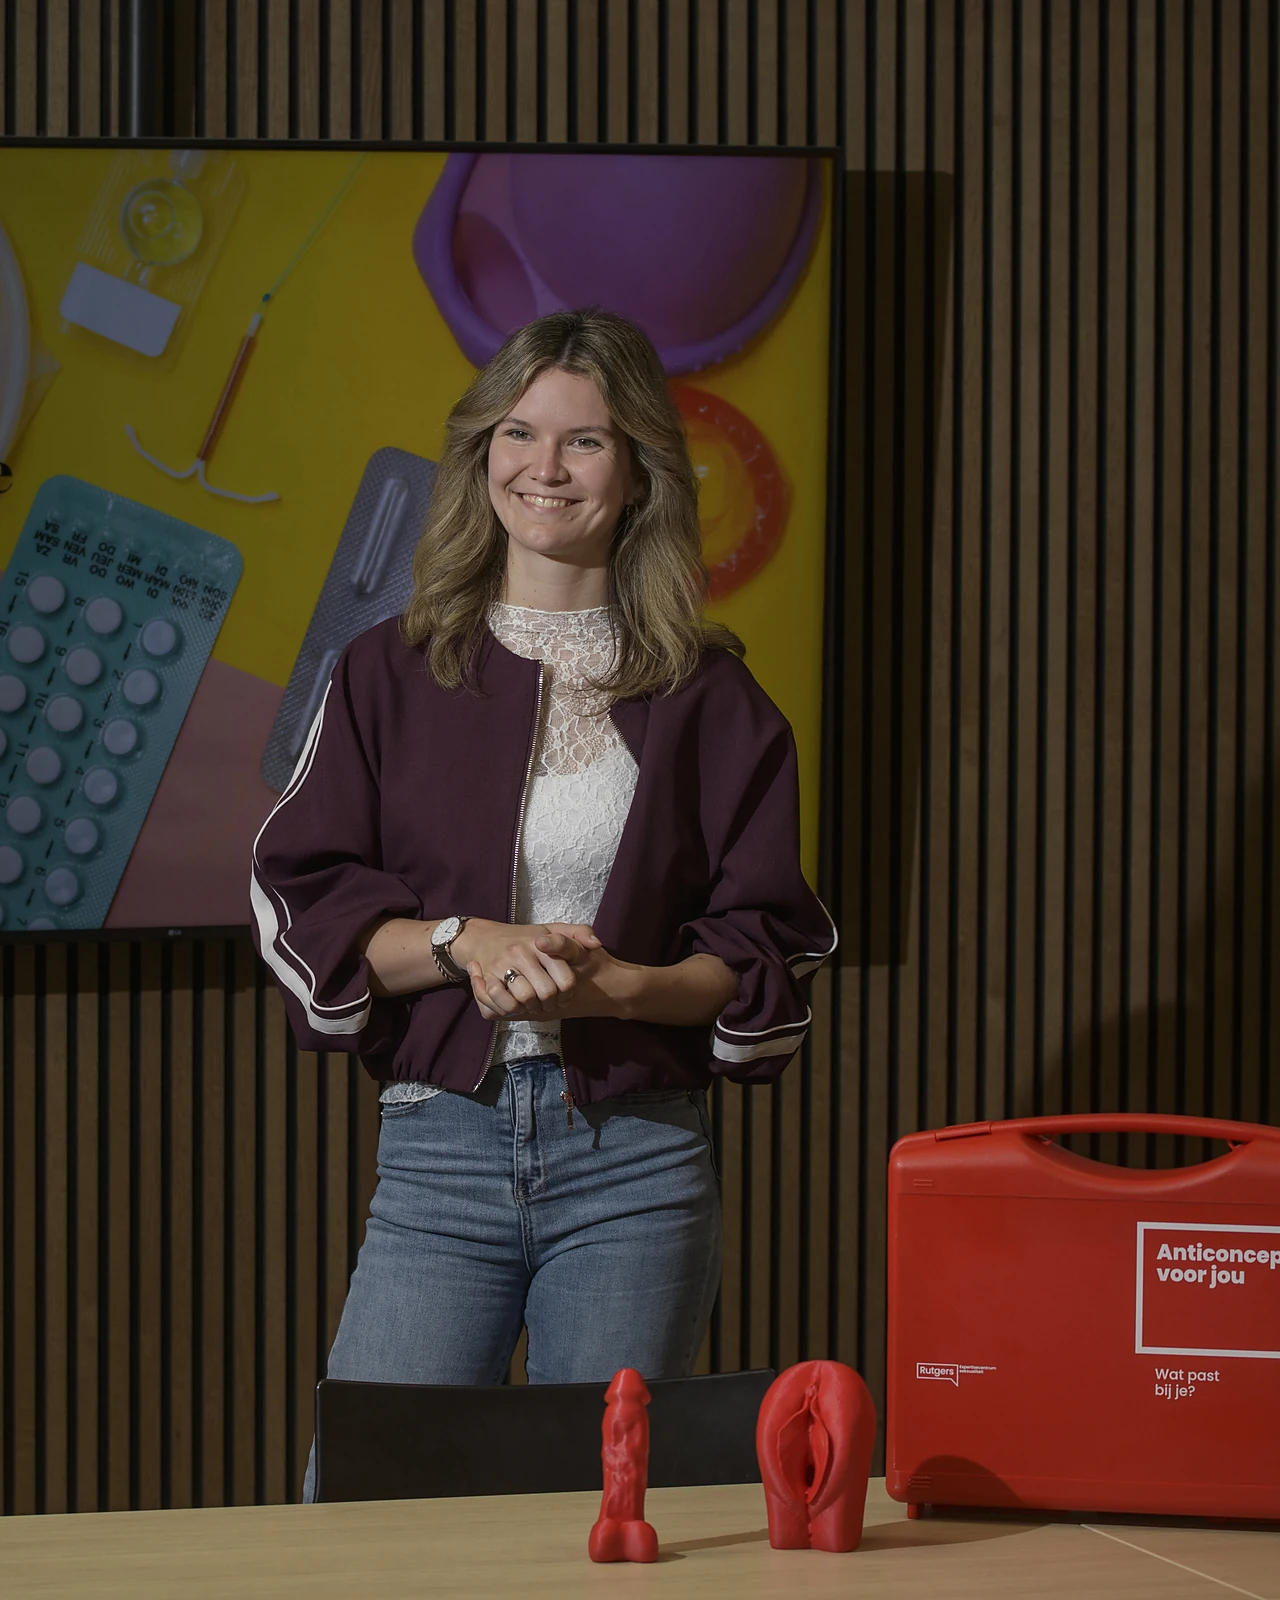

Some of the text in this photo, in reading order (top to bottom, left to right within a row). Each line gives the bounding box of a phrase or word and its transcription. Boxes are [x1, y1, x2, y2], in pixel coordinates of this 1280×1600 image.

[45, 520, 60, 534] SA
[34, 530, 60, 547] SAM
[72, 532, 88, 544] FR
[36, 543, 52, 557] ZA
[64, 540, 86, 557] VEN
[98, 542, 116, 555] DO
[62, 553, 78, 567] VR
[91, 552, 114, 567] JEU
[127, 554, 142, 566] MI
[90, 564, 108, 578] DO
[117, 562, 144, 579] MER
[155, 564, 168, 576] DI
[14, 571, 29, 586] 15
[116, 575, 135, 590] WO
[144, 575, 170, 590] MAR
[146, 587, 159, 599] DI
[75, 597, 86, 606] 8
[34, 692, 48, 709] 10
[1156, 1264, 1245, 1289] voor jou
[919, 1366, 954, 1377] Rutgers
[1154, 1368, 1220, 1384] Wat past
[1154, 1384, 1196, 1400] bij je?
